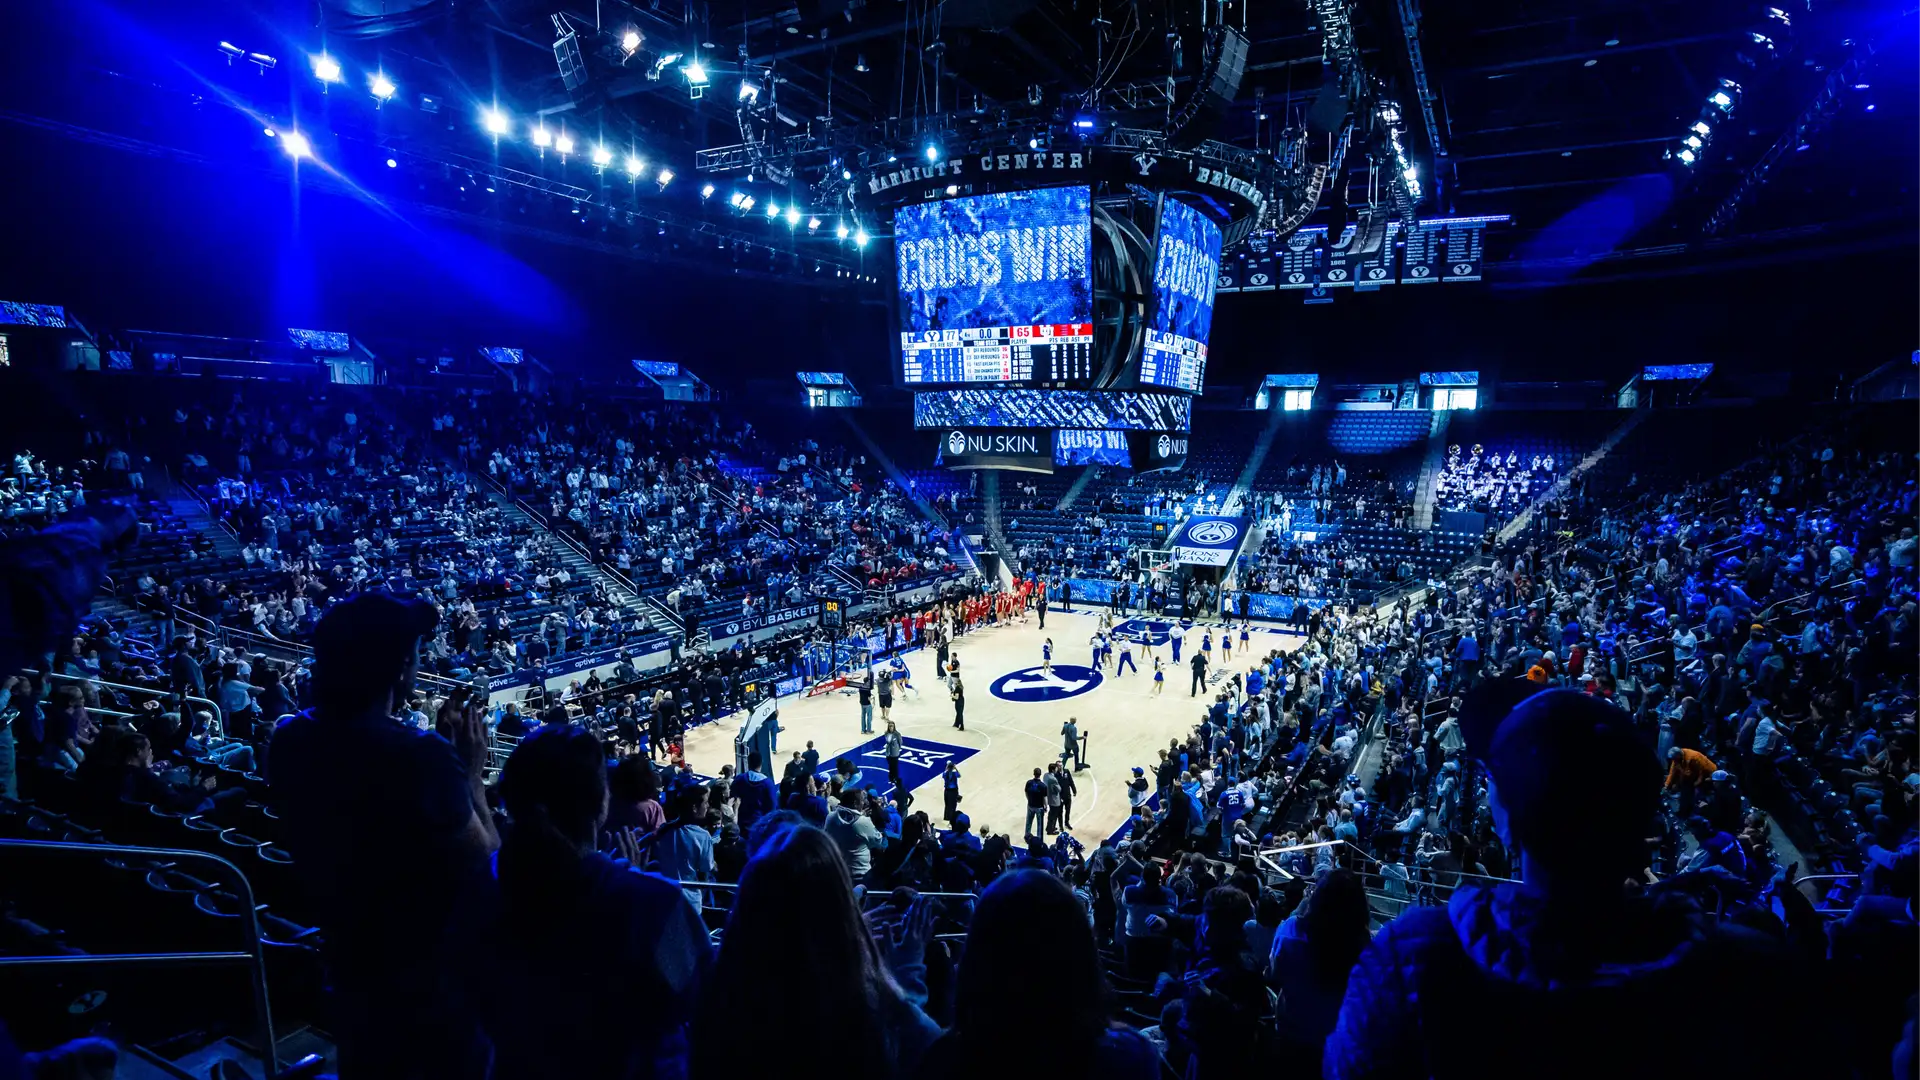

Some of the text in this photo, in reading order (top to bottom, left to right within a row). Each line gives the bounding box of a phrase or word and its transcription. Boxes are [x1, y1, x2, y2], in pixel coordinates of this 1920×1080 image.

[981, 153, 1083, 171] CENTER
[899, 225, 1086, 292] COUGS WIN
[946, 331, 955, 340] 77
[980, 329, 992, 339] 0.0
[1016, 327, 1030, 337] 65
[968, 435, 992, 452] NU
[651, 640, 669, 650] aptive
[575, 658, 596, 668] aptive
[1228, 794, 1239, 805] 25
